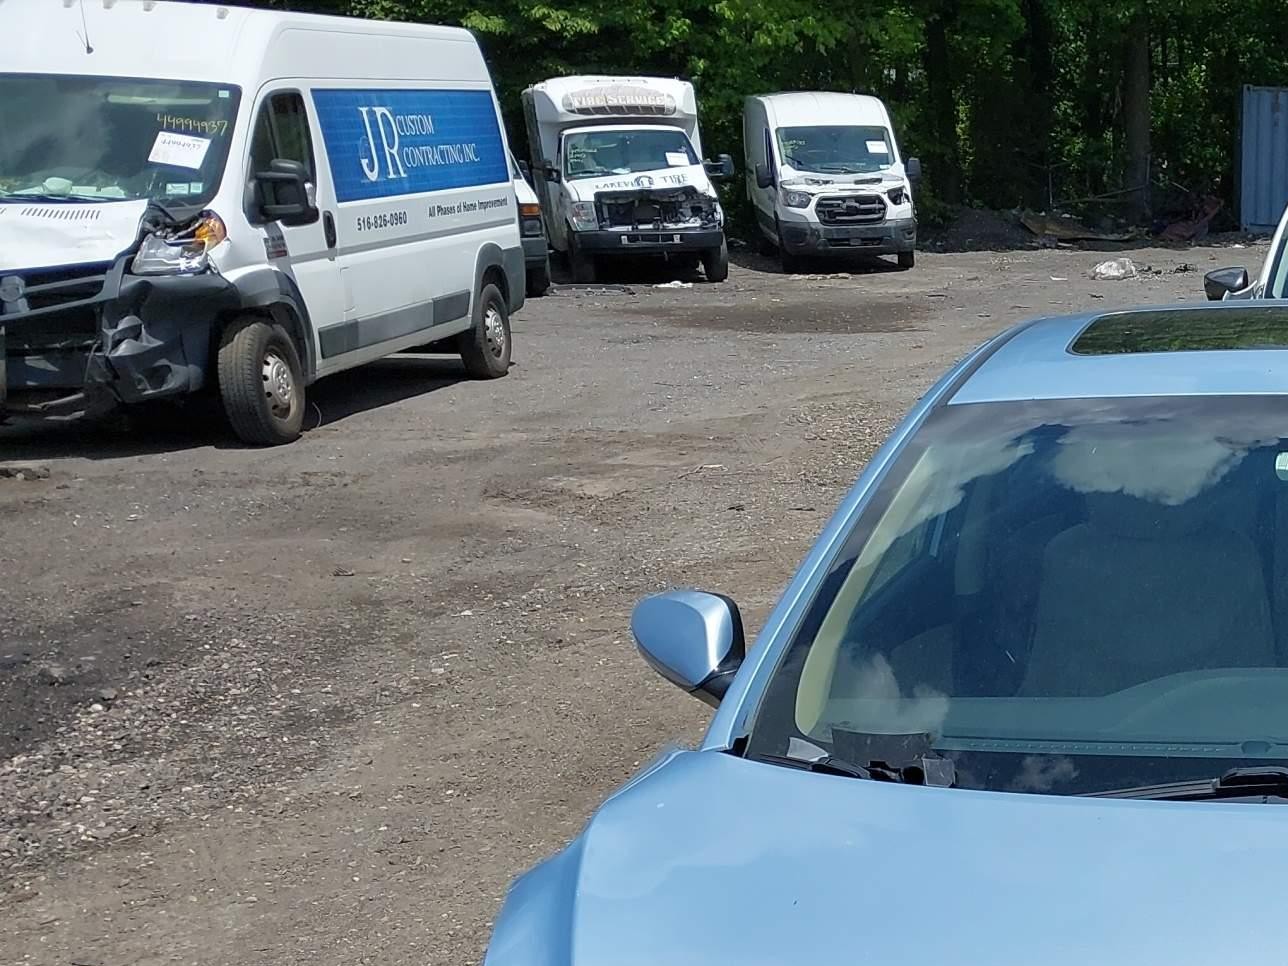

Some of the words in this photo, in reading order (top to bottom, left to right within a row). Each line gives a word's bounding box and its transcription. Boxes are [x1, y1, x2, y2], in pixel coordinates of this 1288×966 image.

[156, 113, 228, 136] 44994937
[396, 115, 434, 135] CUSTOM
[357, 106, 407, 182] JR
[403, 145, 463, 168] CONTRACTING
[464, 143, 480, 162] INC.
[660, 174, 688, 184] TIRE
[437, 204, 456, 216] Phases
[357, 211, 408, 231] 516-826-0960
